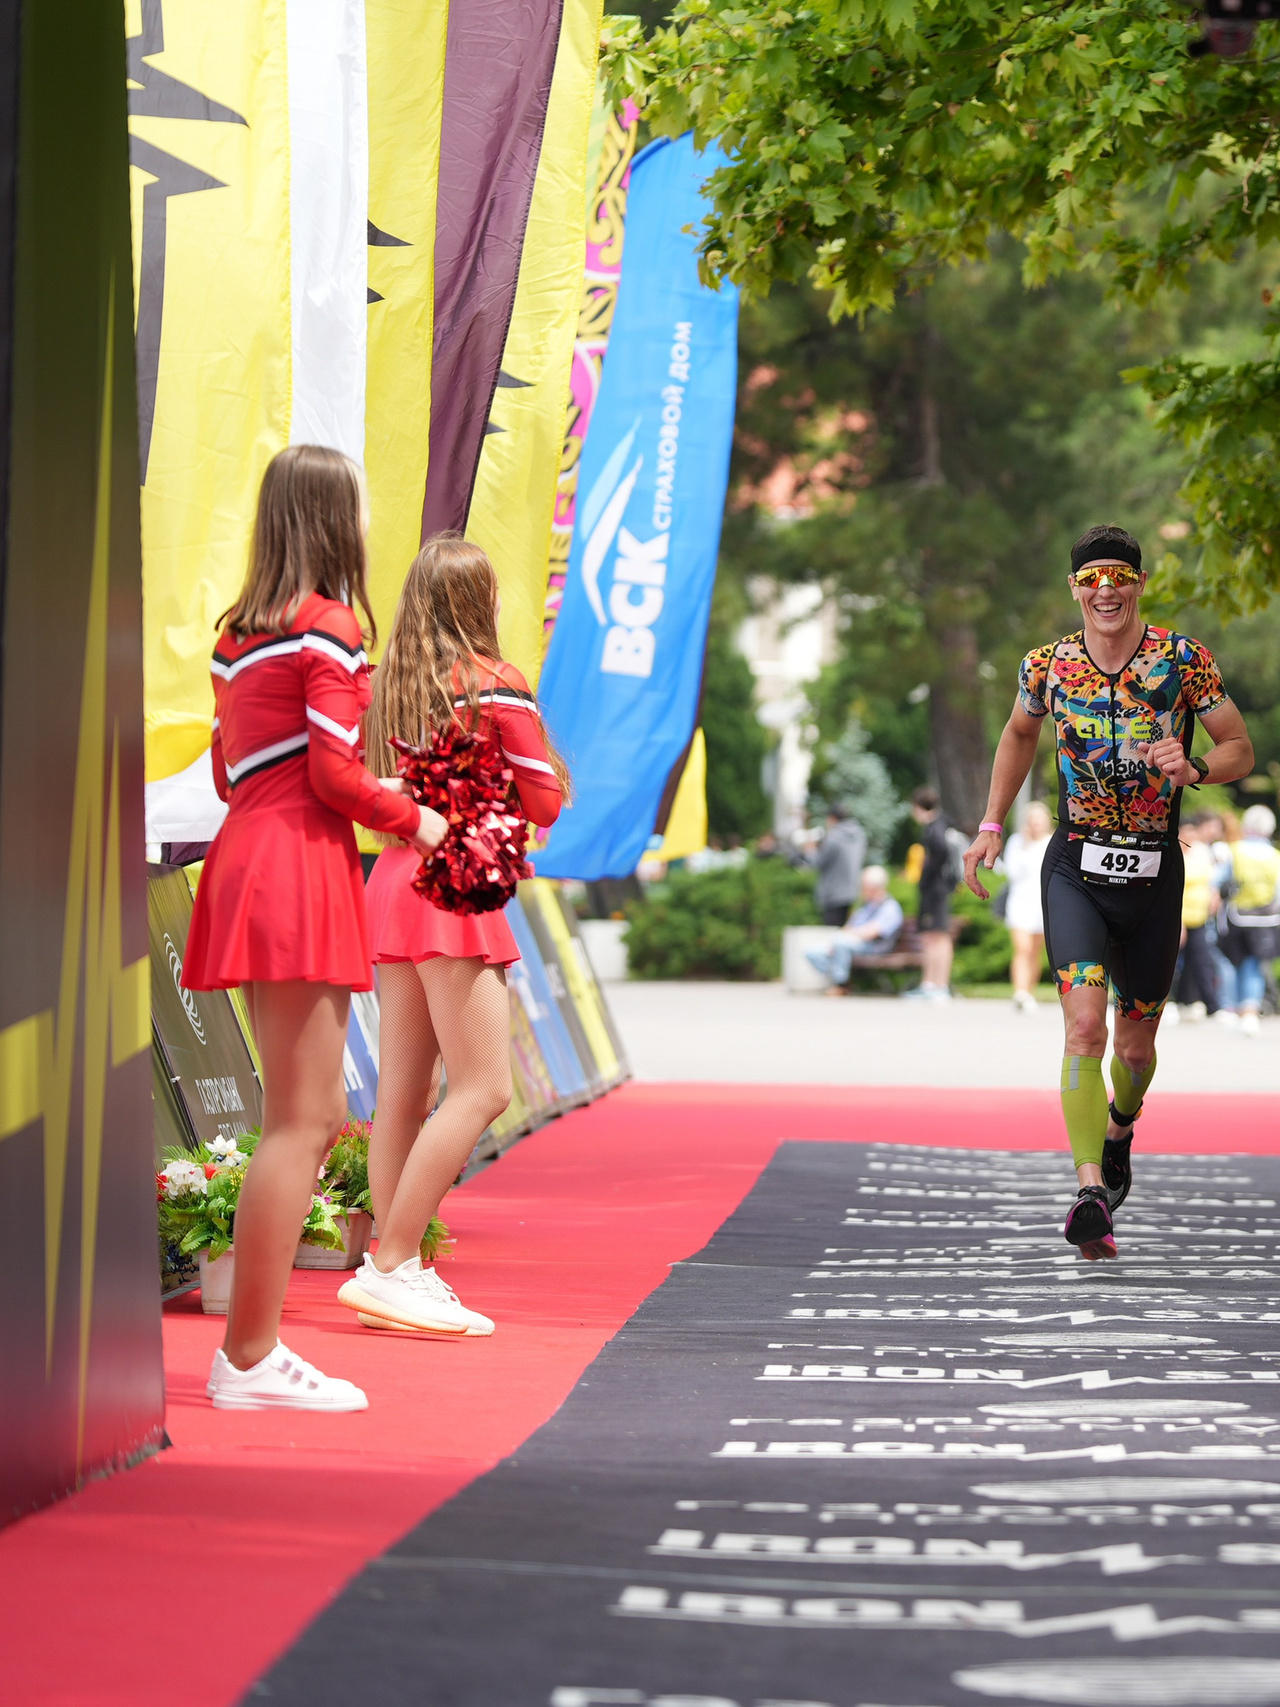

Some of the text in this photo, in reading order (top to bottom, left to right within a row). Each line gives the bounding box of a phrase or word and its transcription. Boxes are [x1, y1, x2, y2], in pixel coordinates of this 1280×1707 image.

[653, 322, 693, 531] СТРАХОВОЙ ДОМ
[600, 526, 670, 678] ВСК
[1101, 852, 1140, 873] 492
[1108, 876, 1128, 884] NIKITA
[762, 1364, 1025, 1379] IRON
[657, 1529, 1025, 1567] IRON
[617, 1585, 1024, 1626] IRON
